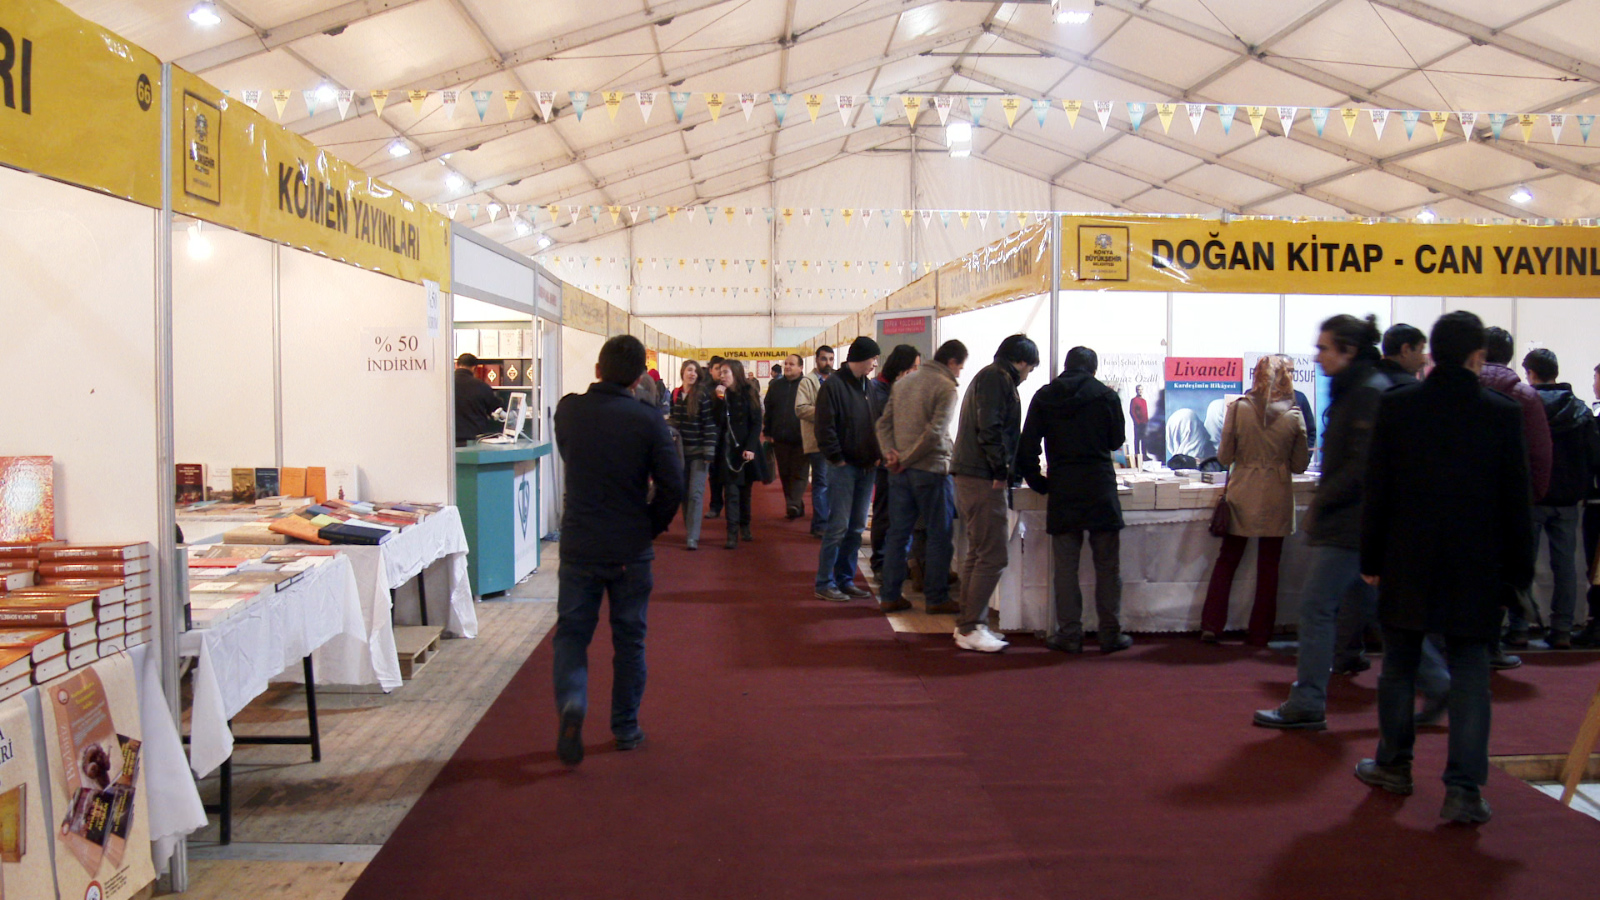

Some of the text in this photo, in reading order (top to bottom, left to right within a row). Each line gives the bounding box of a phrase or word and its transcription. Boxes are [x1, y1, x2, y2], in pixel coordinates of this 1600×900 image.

[138, 81, 151, 104] 66
[353, 197, 420, 261] YAYINLARI
[1152, 231, 1275, 271] DOĞAN
[1287, 234, 1384, 273] KİTAP
[1394, 258, 1404, 266] -
[1415, 244, 1483, 274] CAN
[375, 335, 419, 353] % 50
[367, 356, 427, 372] İNDİRİM
[1174, 361, 1237, 377] Livaneli
[1173, 382, 1236, 390] Kardeşimin Hikâyesi
